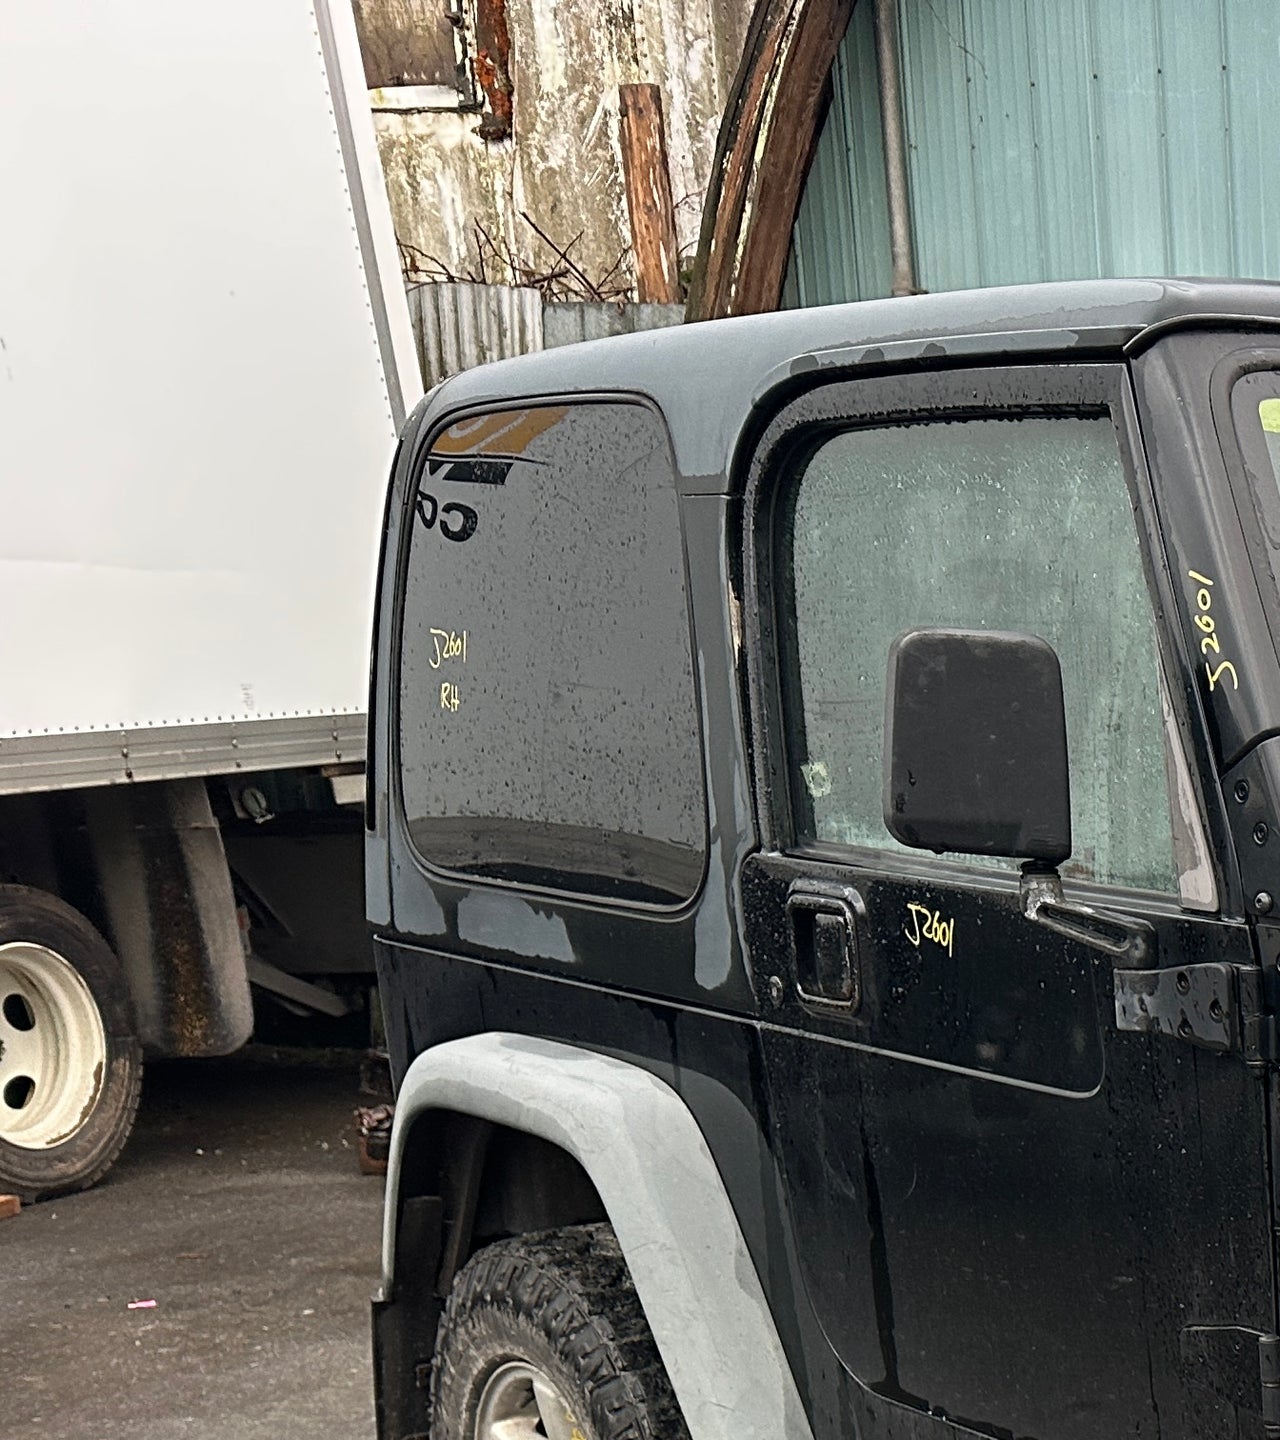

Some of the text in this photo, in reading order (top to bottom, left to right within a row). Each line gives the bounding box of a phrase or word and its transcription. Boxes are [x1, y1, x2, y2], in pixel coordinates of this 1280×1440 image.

[429, 628, 467, 669] J2601
[1188, 570, 1239, 691] J2601
[905, 904, 955, 957] J2601
